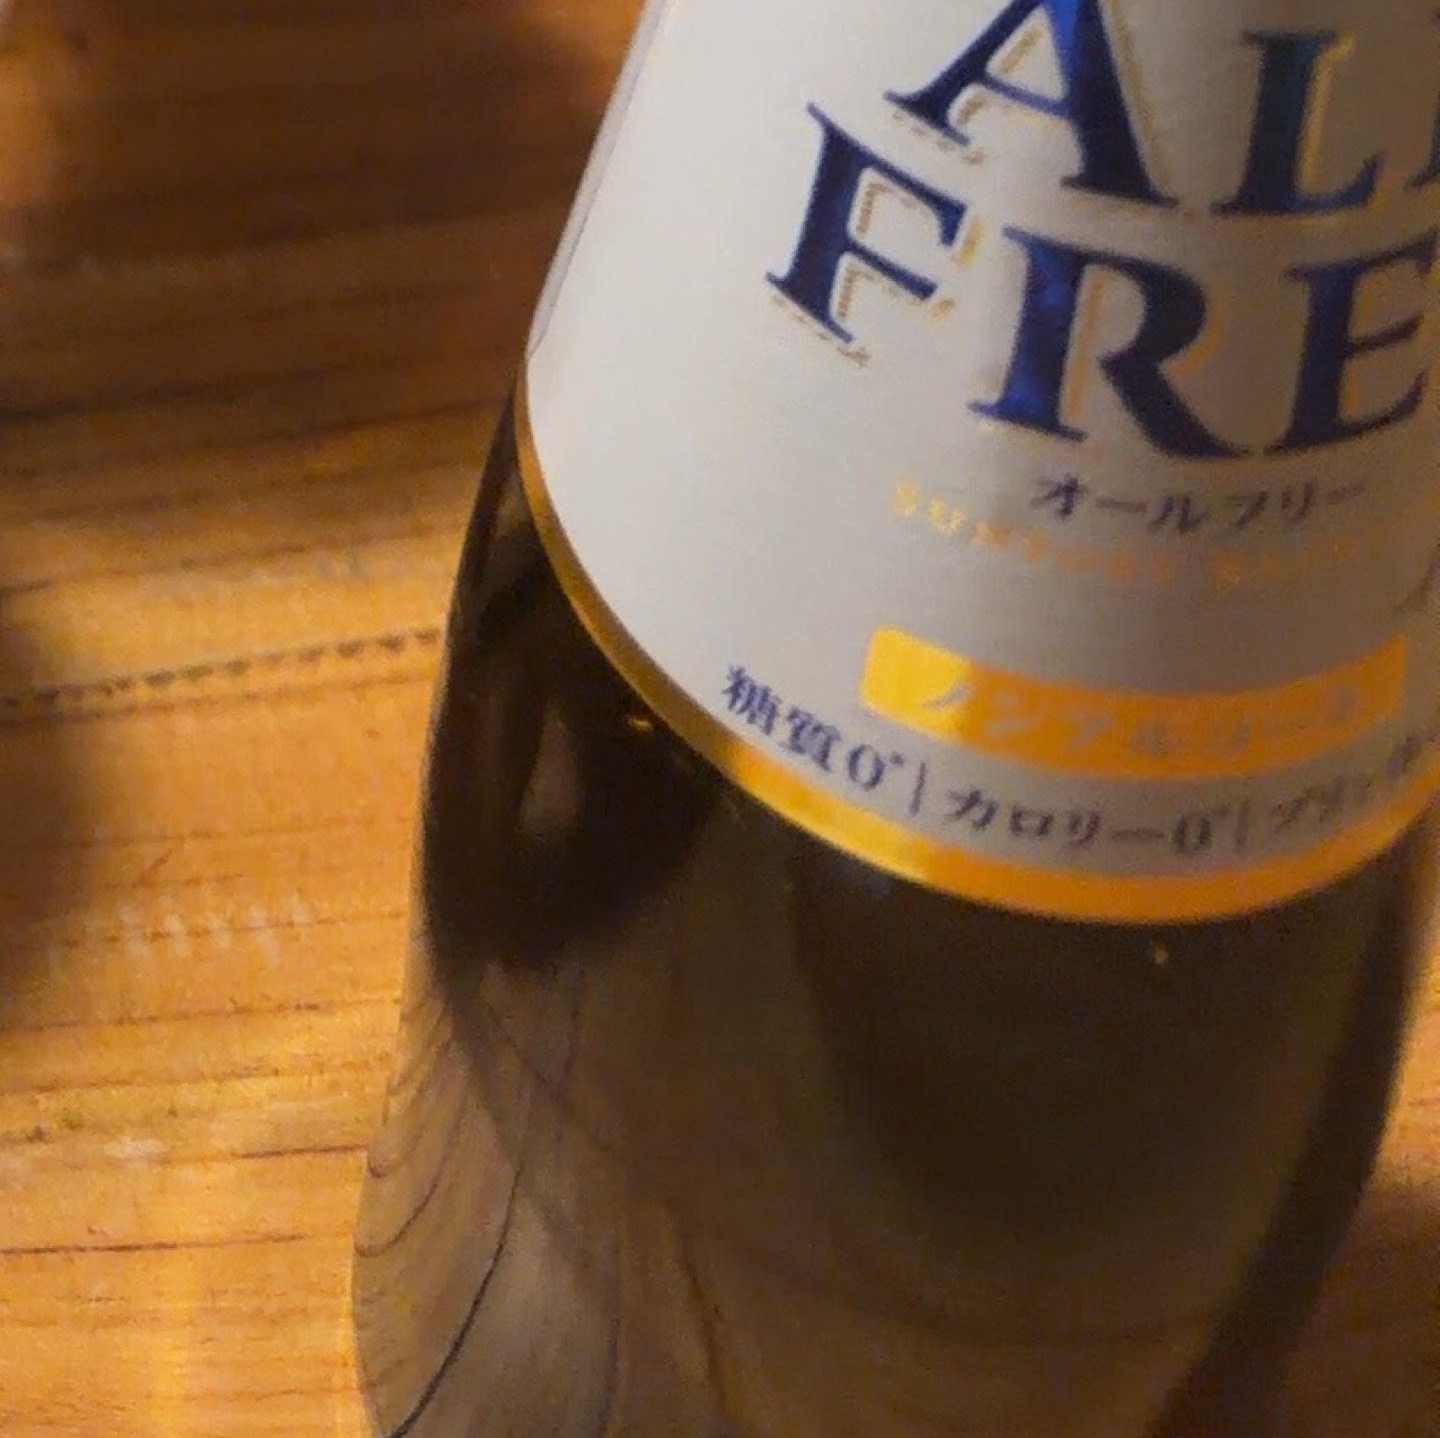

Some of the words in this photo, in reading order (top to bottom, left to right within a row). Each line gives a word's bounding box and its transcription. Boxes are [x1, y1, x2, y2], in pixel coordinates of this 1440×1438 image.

[1030, 472, 1369, 535] オールフリー
